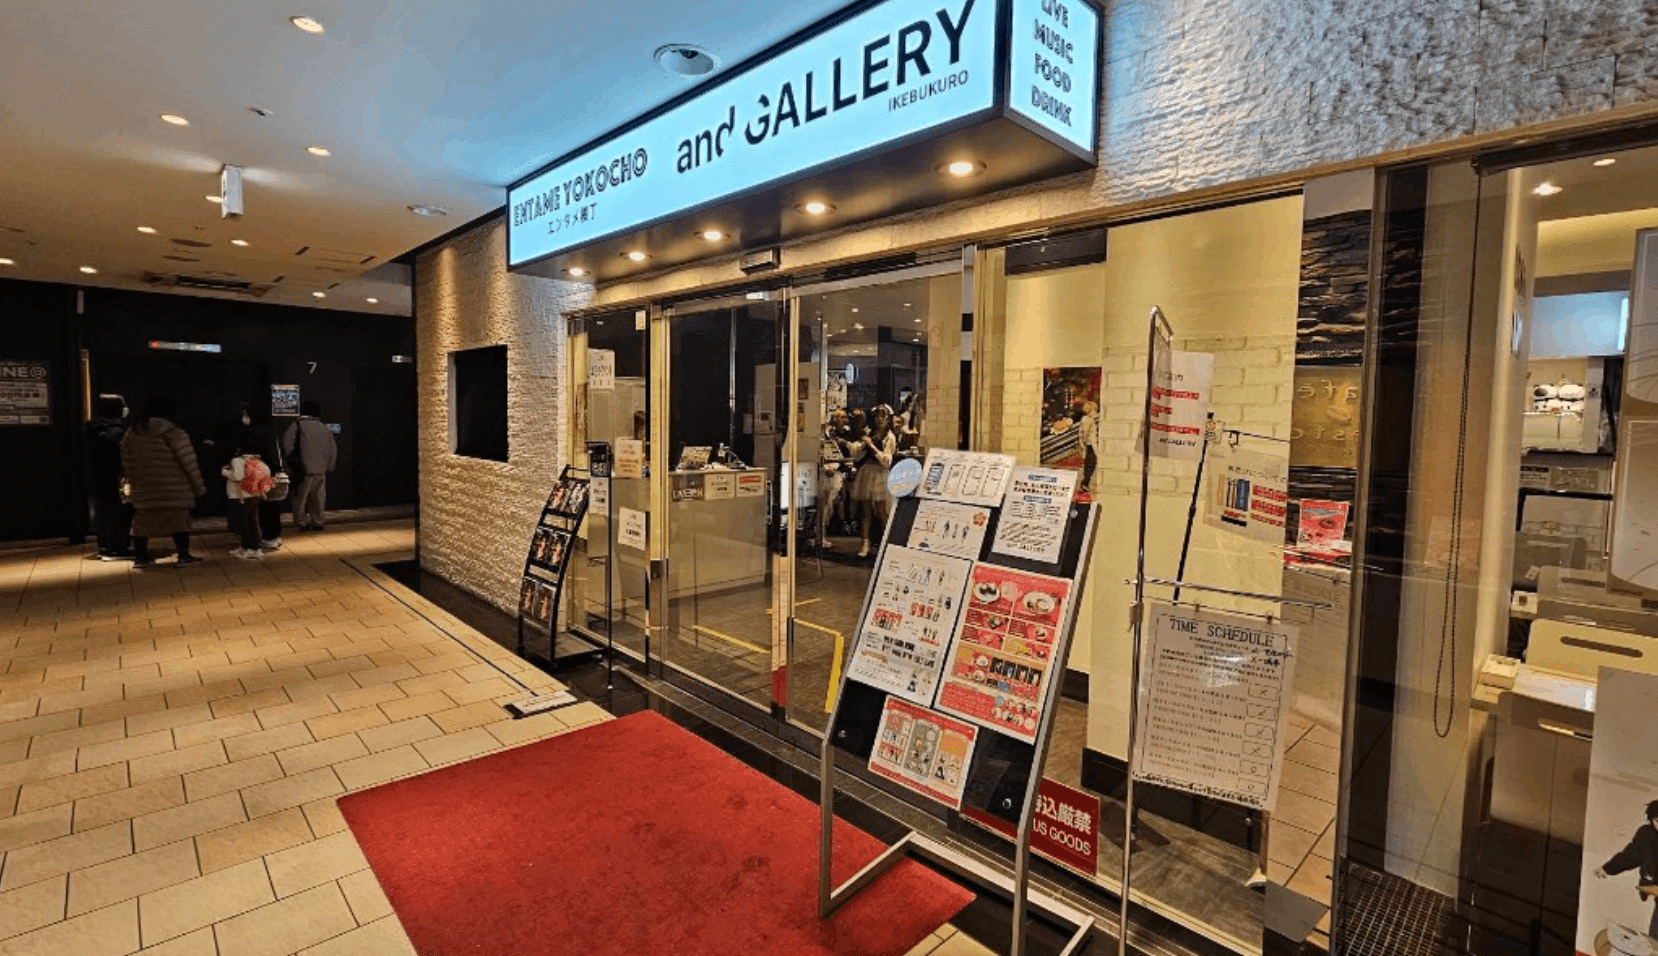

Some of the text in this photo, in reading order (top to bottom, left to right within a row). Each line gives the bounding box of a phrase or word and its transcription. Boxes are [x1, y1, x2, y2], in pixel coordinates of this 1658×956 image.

[1034, 18, 1073, 64] MUSIC
[676, 0, 976, 173] and GALLERY
[888, 69, 970, 112] IKEBUKURO
[1034, 53, 1071, 93] FOOD
[1031, 89, 1072, 127] DRINK
[513, 147, 648, 227] ENTAME YOKOCHO
[306, 361, 317, 375] 7
[1169, 618, 1198, 634] TIME
[1206, 625, 1275, 647] SCHEDULE
[1033, 818, 1091, 856] US GOODS
